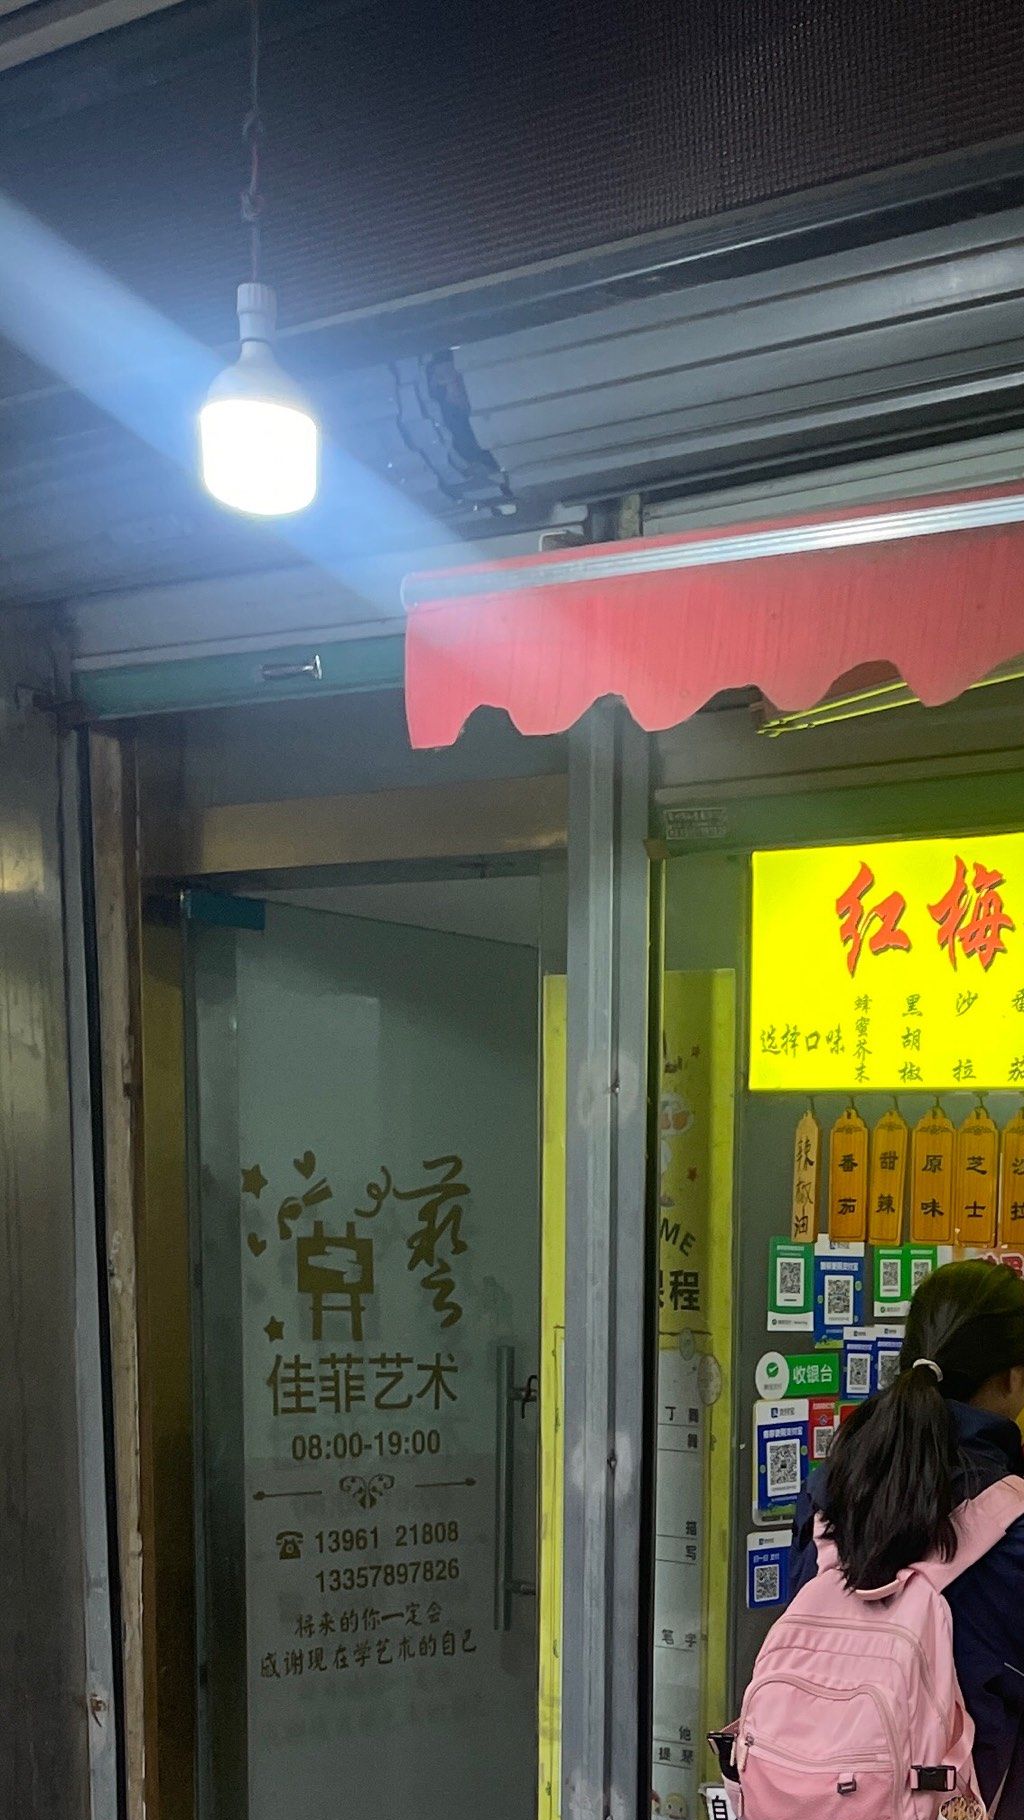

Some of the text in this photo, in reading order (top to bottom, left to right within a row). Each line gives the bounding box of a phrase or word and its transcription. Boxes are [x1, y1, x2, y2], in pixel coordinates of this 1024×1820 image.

[760, 1023, 846, 1058] 选择口味
[853, 994, 873, 1083] 蜂蜜芥末
[898, 994, 924, 1082] 黑胡椒
[953, 991, 979, 1081] 沙拉
[838, 1154, 858, 1214] 番茄
[876, 1151, 899, 1214] 甜辣
[921, 1154, 944, 1217] 原味
[965, 1155, 988, 1218] 芝士
[266, 1353, 459, 1416] 佳菲艺术
[793, 1364, 833, 1384] 收银台
[292, 1430, 441, 1460] 08:00-19:00
[315, 1521, 460, 1553] 13961 21808
[315, 1558, 460, 1592] 13357897826
[295, 1601, 443, 1638] 将来的你一定会
[261, 1629, 477, 1678] 感谢现在学艺术的自己
